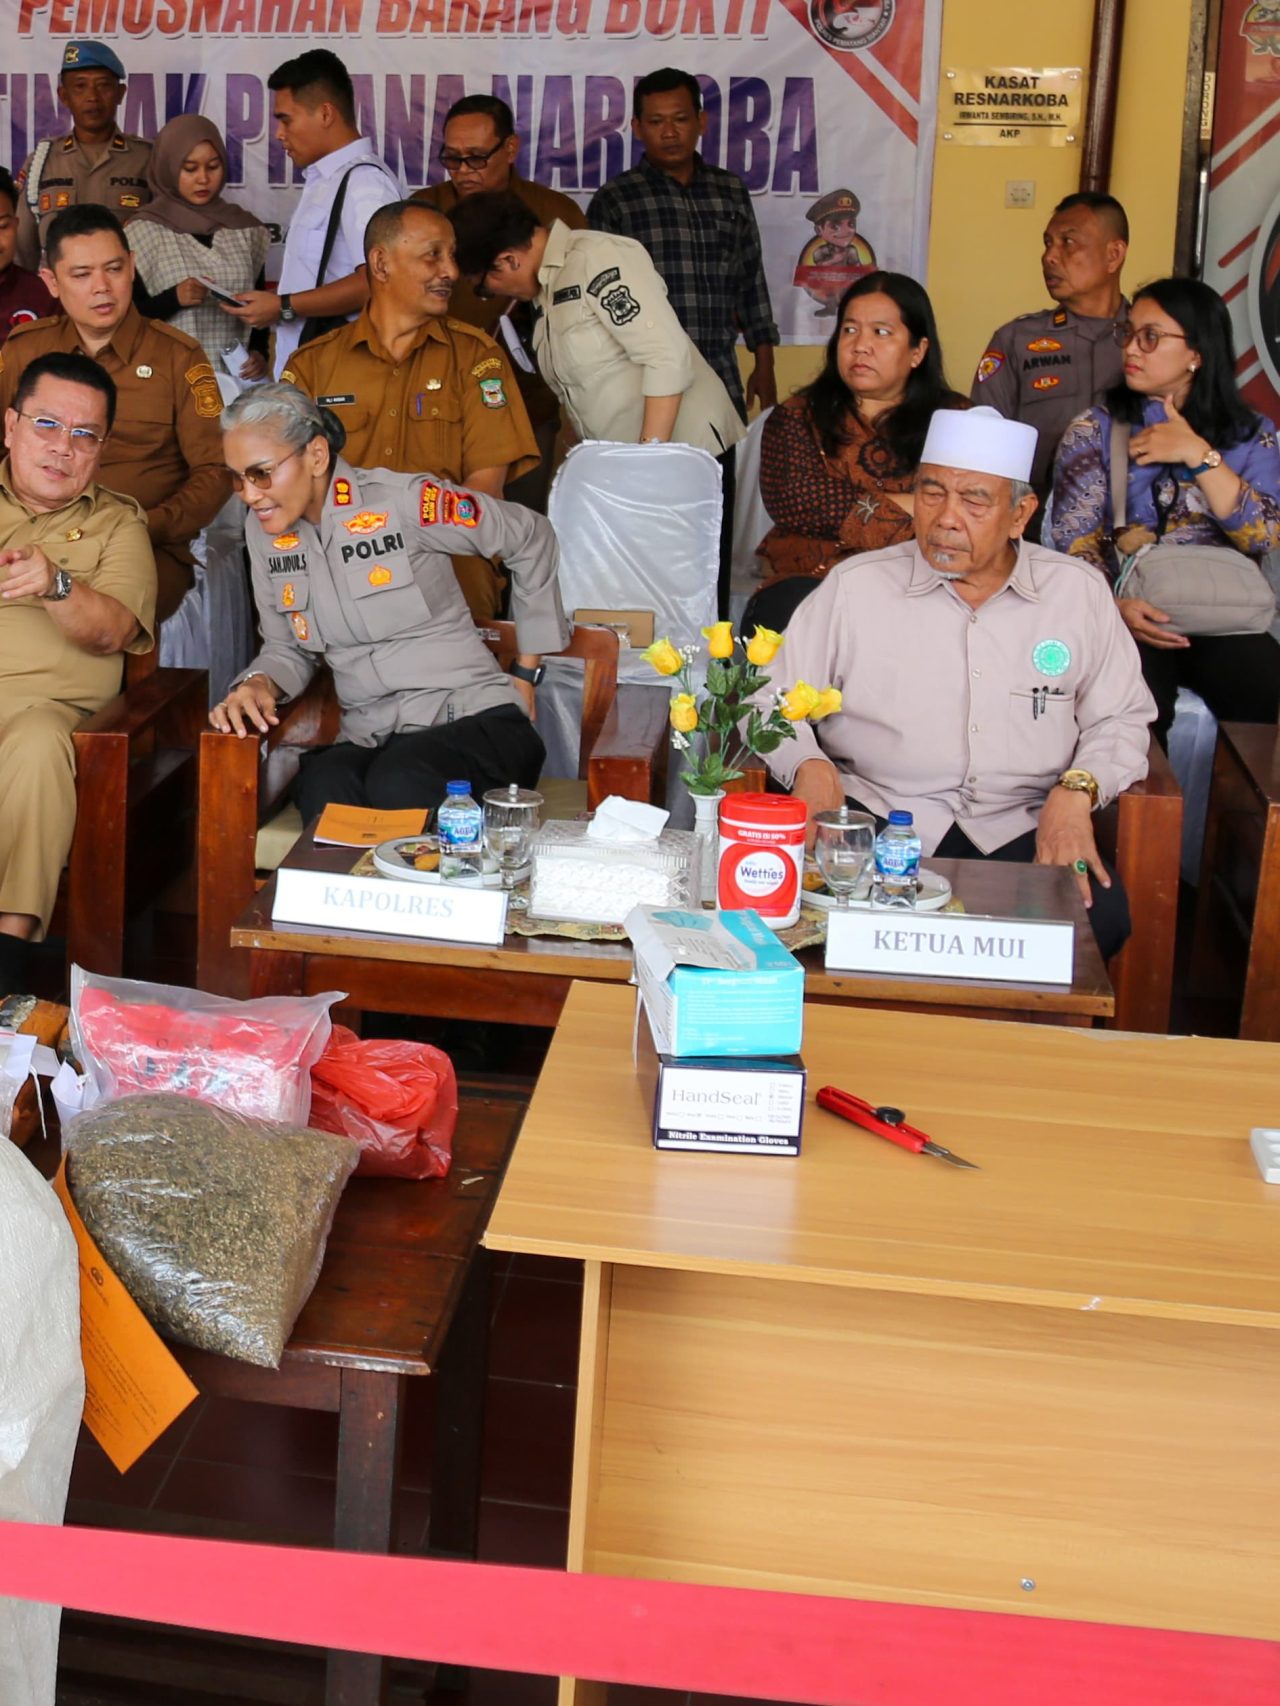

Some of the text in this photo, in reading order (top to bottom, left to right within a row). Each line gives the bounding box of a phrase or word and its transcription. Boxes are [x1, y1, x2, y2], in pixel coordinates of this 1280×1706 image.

[18, 0, 772, 37] PEMUSNAHAN BARANG BUKTI
[985, 76, 1040, 89] KASAT
[954, 93, 1068, 107] RESNARKOBA
[1000, 129, 1020, 138] AKP
[1023, 355, 1071, 371] ARWAN
[341, 533, 405, 564] POLRI
[740, 866, 784, 879] Wetties
[323, 886, 454, 918] KAPOLRES
[874, 930, 1026, 959] KETUA MUI
[672, 1089, 760, 1106] HandSeal
[668, 1131, 789, 1145] Nitrile Examination Gloves
